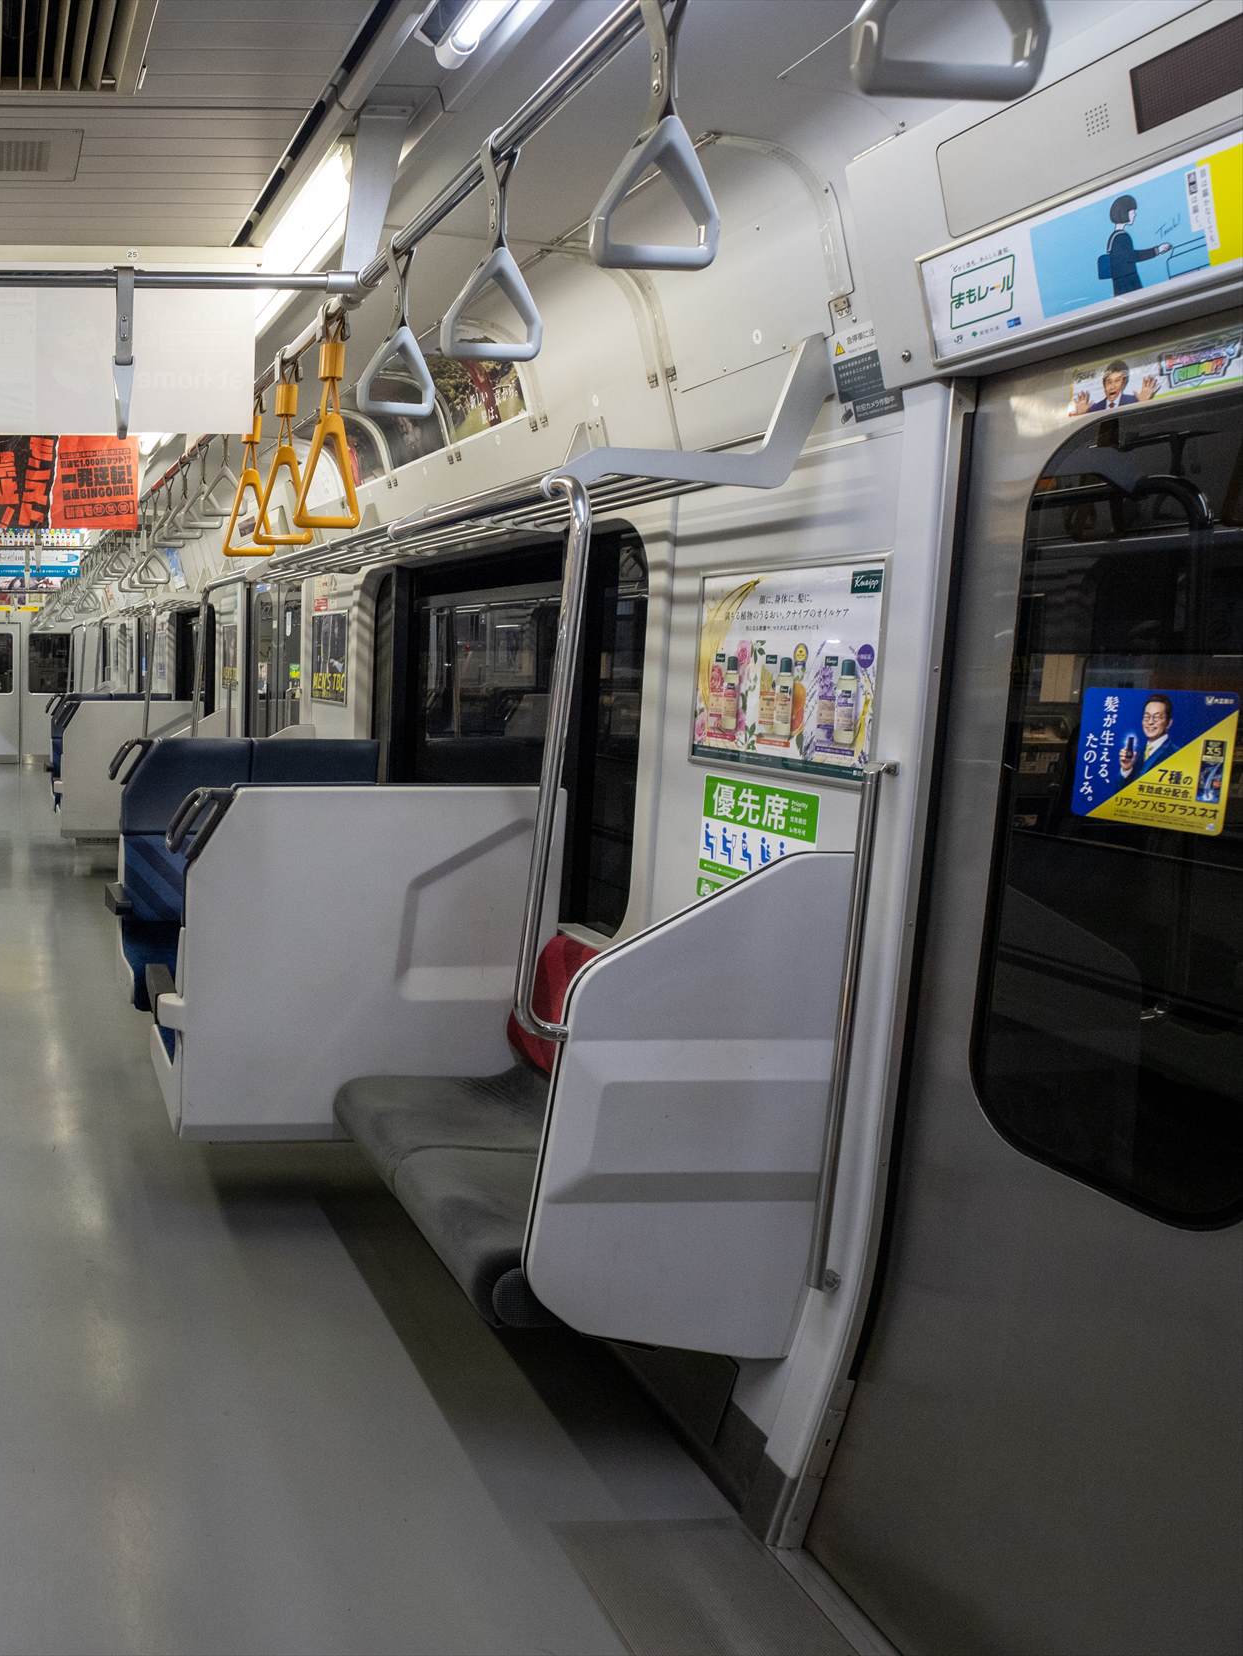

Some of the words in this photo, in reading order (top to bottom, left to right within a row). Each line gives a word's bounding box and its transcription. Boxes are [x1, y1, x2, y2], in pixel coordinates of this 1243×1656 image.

[952, 275, 1013, 309] まもレール
[854, 575, 879, 589] Kneipp
[1098, 696, 1120, 784] 髪が生える、
[1206, 747, 1222, 755] X5
[1079, 733, 1099, 802] たのしみ。
[1157, 768, 1193, 785] 7種の
[712, 783, 789, 830] 優先席
